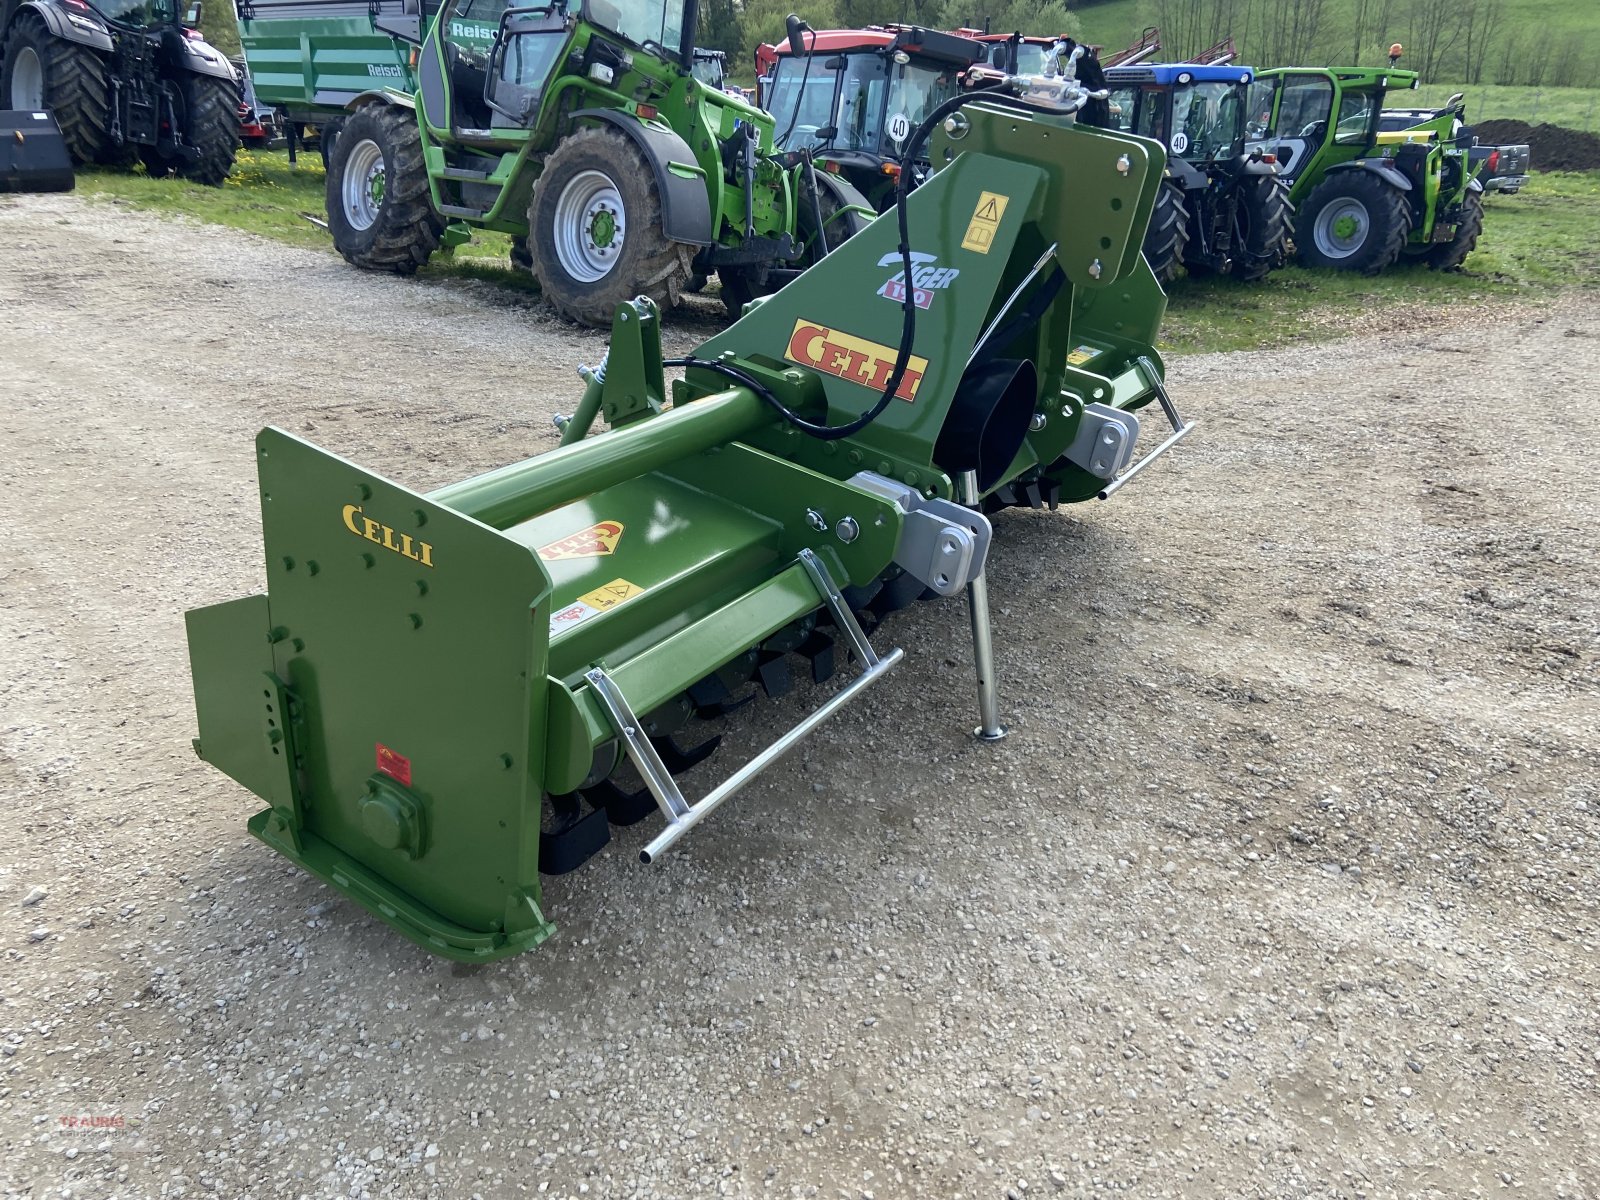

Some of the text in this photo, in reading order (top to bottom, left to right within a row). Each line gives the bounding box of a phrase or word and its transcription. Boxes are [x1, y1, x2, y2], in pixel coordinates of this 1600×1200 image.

[892, 118, 906, 138] 40
[1173, 136, 1185, 150] 40
[790, 324, 923, 401] CELLI
[342, 503, 434, 568] CELLI
